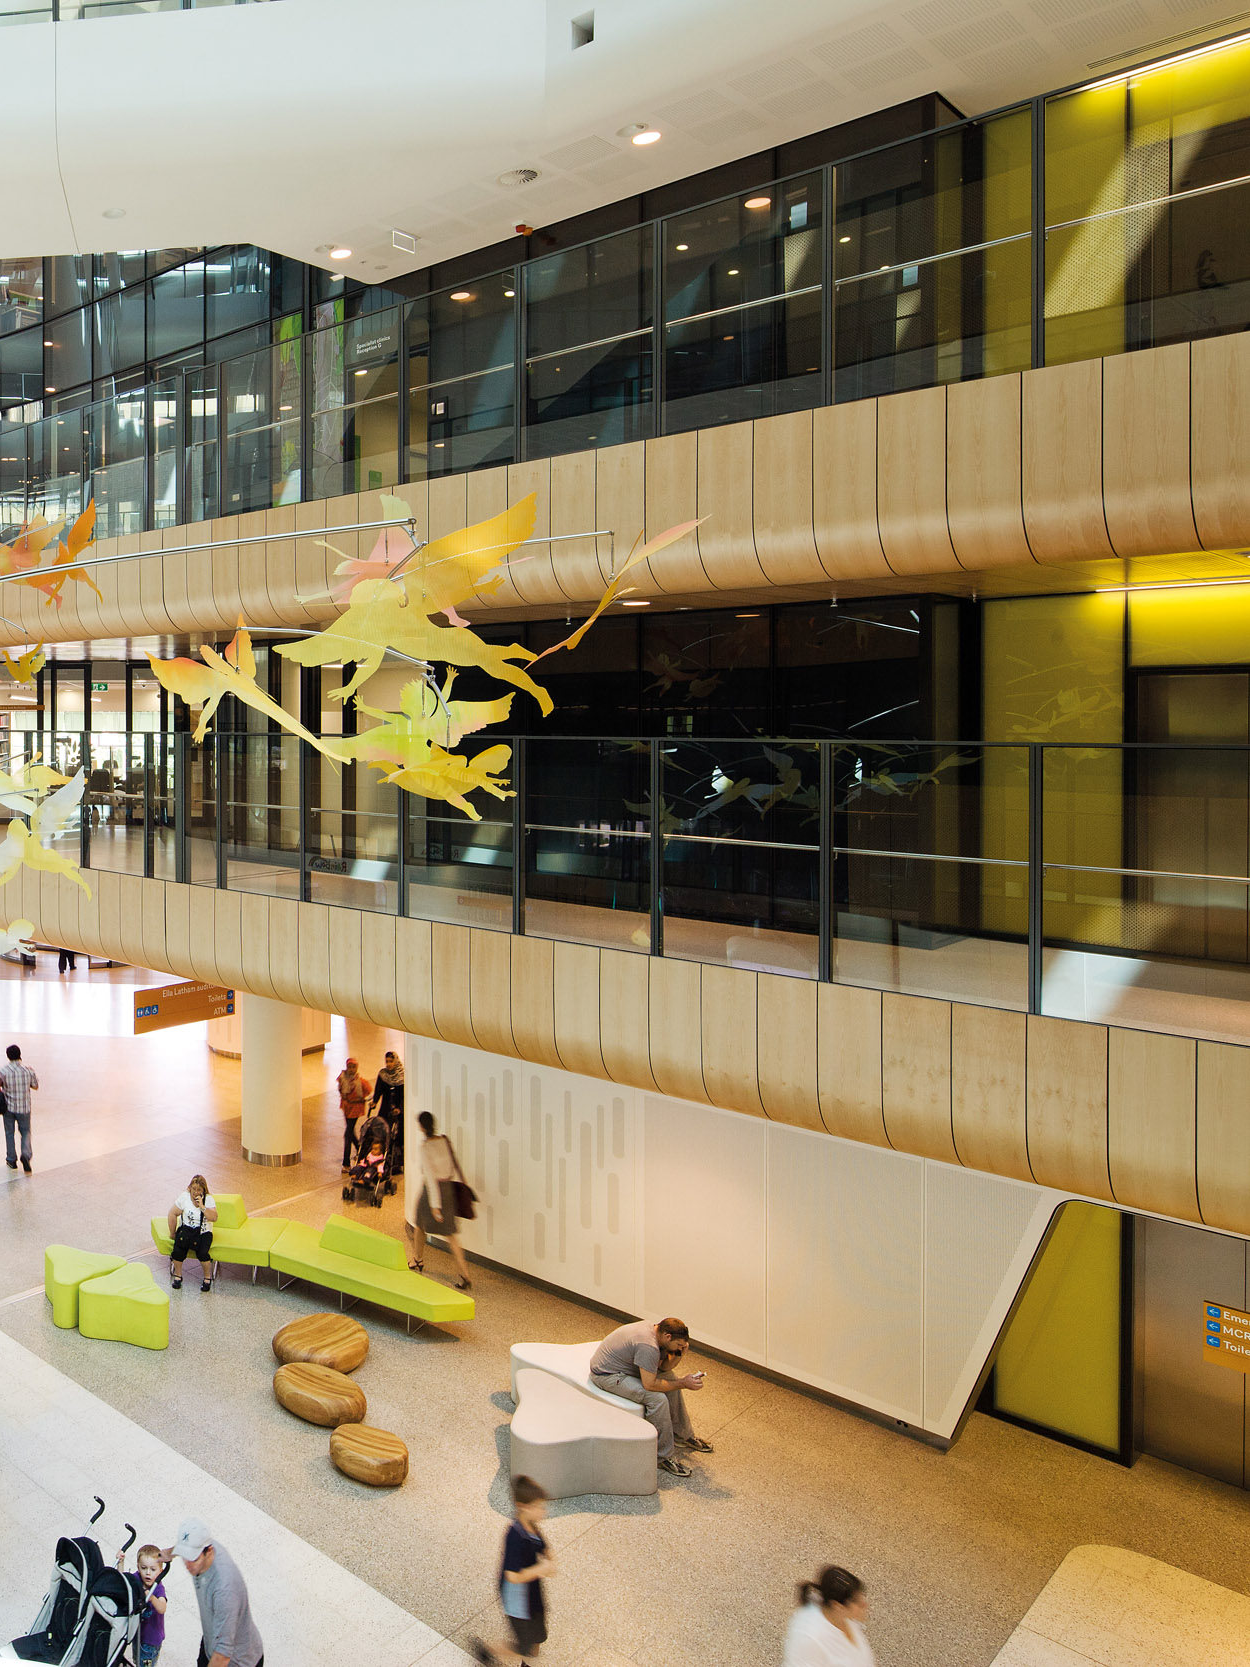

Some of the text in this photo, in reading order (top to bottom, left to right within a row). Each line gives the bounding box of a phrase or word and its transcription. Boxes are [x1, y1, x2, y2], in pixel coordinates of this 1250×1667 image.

[162, 989, 173, 998] Ella
[174, 986, 196, 996] Latham
[207, 994, 226, 1003] Toilets
[213, 1006, 226, 1015] ATM
